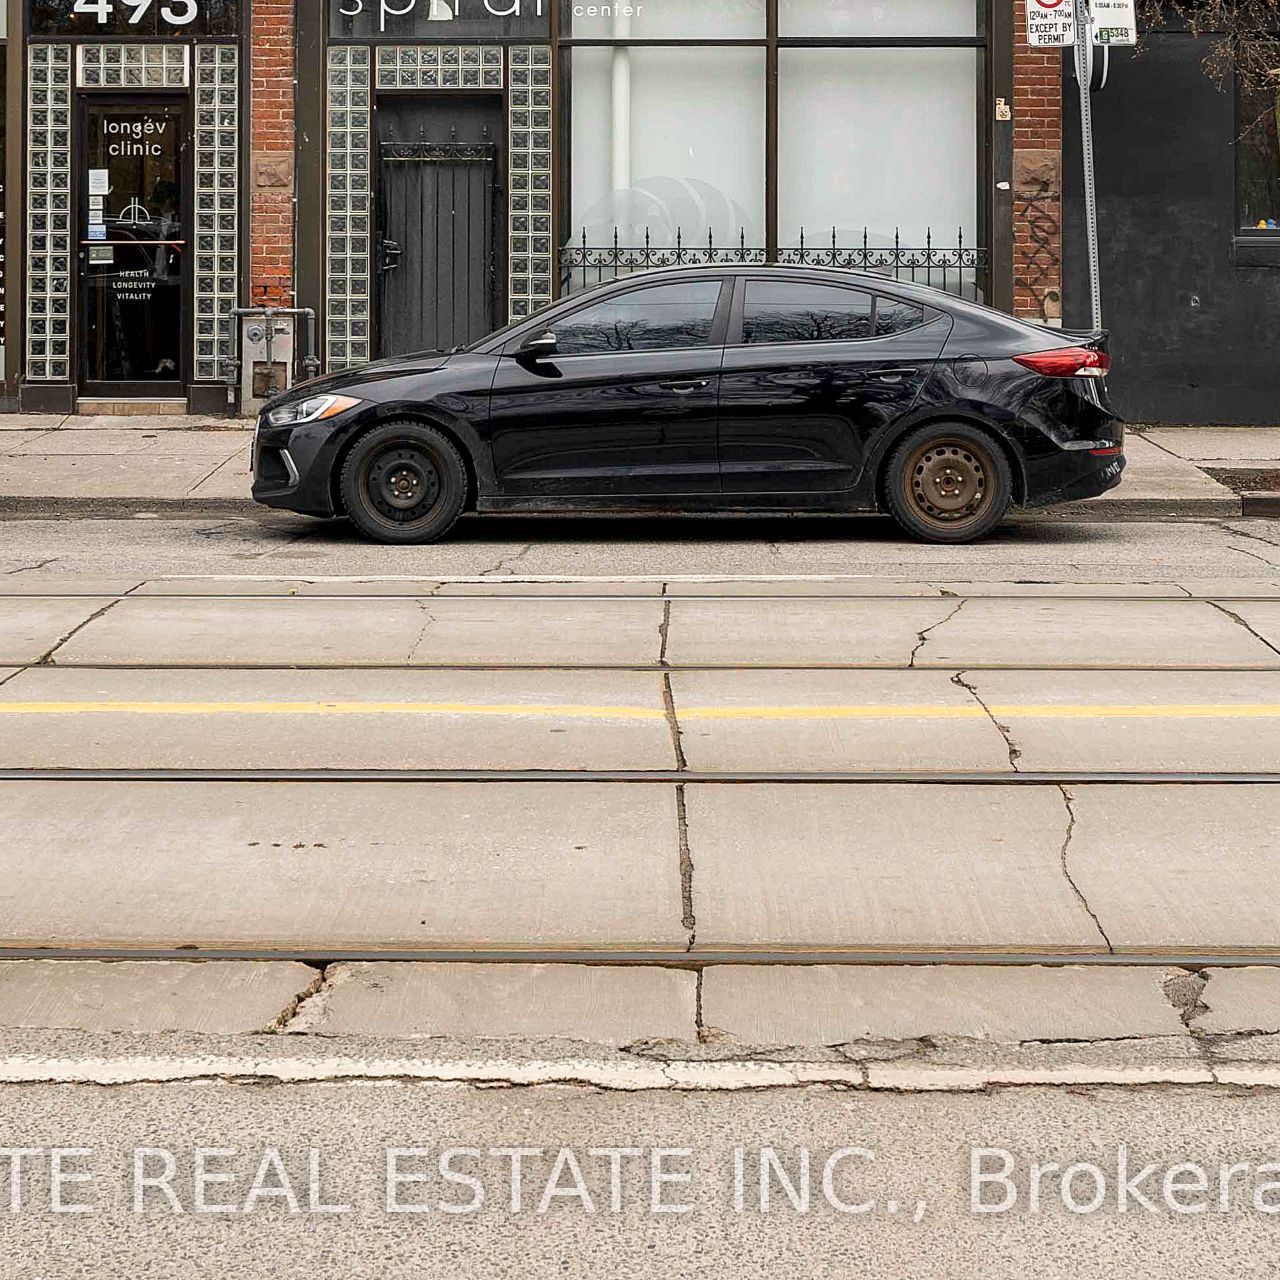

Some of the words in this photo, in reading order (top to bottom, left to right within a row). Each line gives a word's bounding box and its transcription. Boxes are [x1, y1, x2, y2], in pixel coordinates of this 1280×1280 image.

[572, 3, 644, 18] center
[1030, 23, 1058, 34] EXCEPT
[1062, 22, 1072, 32] BY
[1110, 28, 1129, 38] 5348
[1038, 34, 1066, 44] PERMIT
[103, 118, 166, 139] longév
[108, 140, 162, 156] clinic
[120, 270, 150, 278] HEALTH
